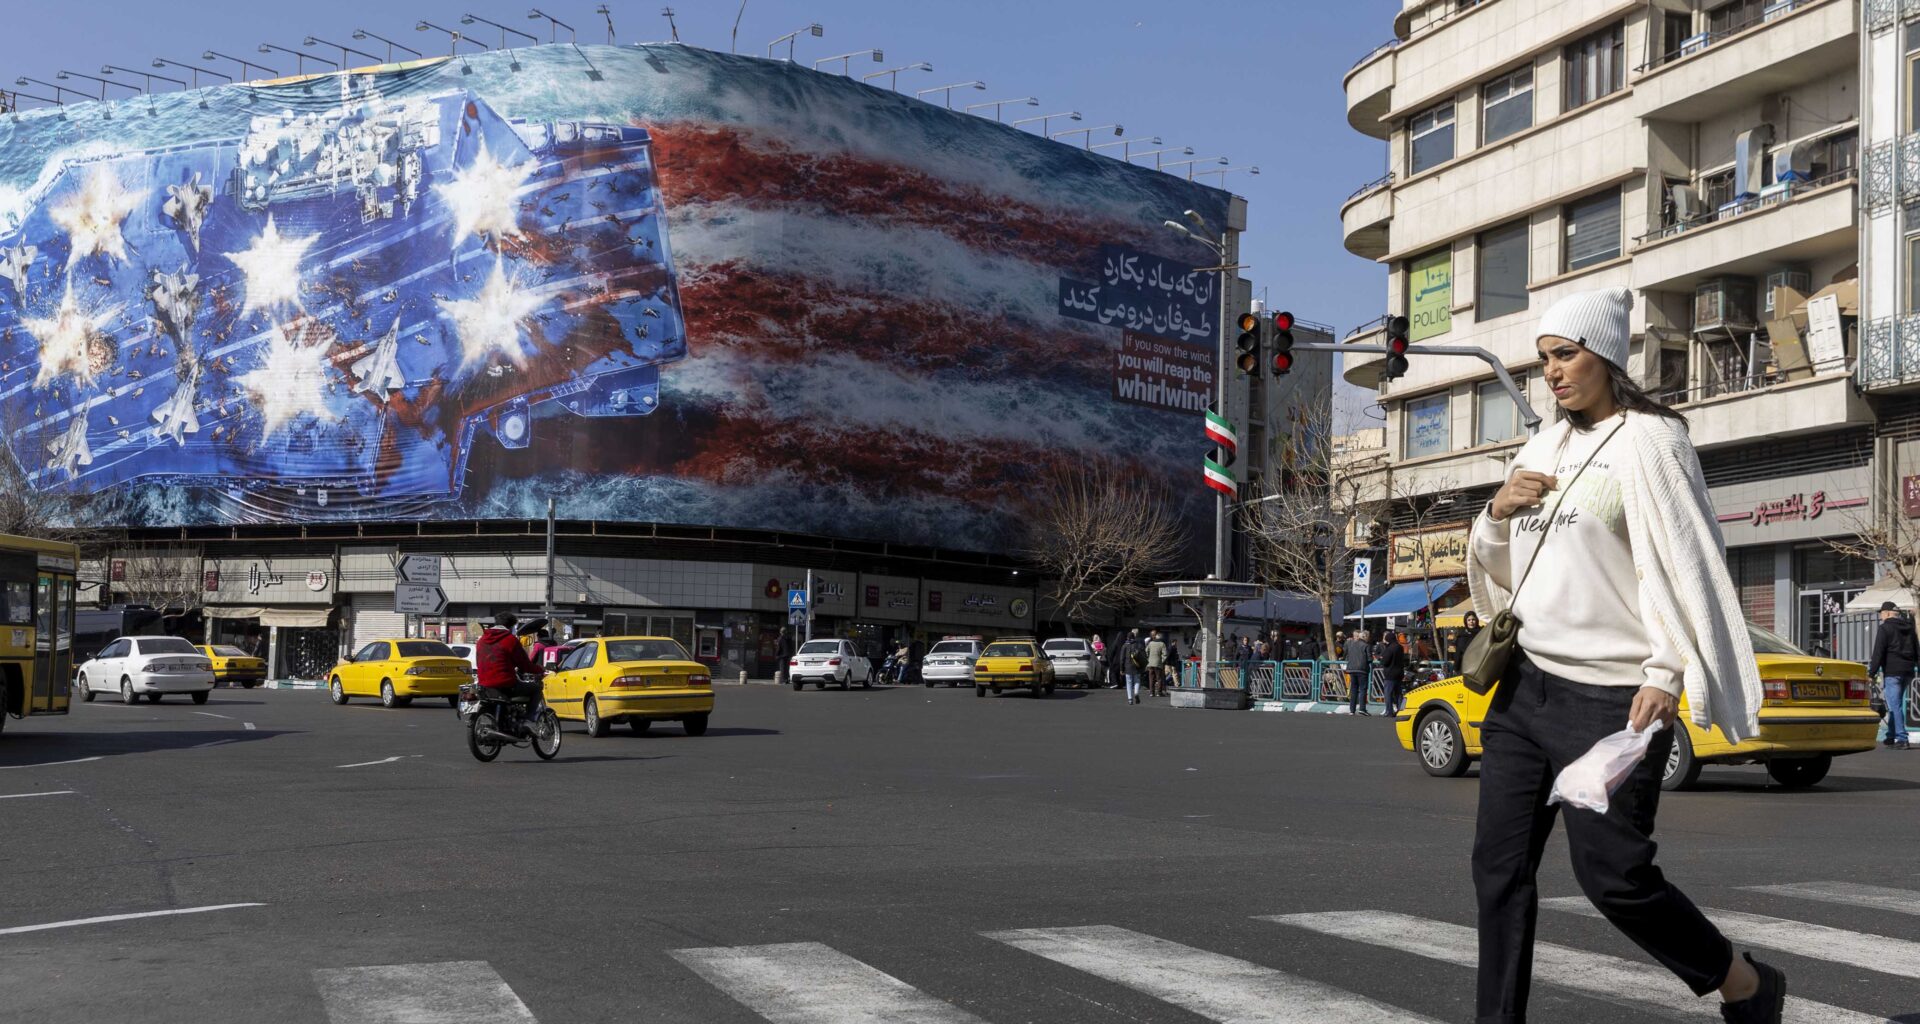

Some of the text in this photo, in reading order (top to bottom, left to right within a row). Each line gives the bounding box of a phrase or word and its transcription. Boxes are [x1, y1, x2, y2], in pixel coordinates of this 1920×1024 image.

[1104, 253, 1145, 291] بکارد
[1148, 263, 1175, 298] باد
[1153, 303, 1212, 341] طوفان
[1413, 305, 1452, 330] POLICE
[1125, 335, 1213, 366] If you sow the wind,
[1118, 353, 1212, 384] you will reap the
[1117, 374, 1211, 413] whirlwind
[1569, 461, 1583, 472] THE
[1515, 514, 1552, 538] New
